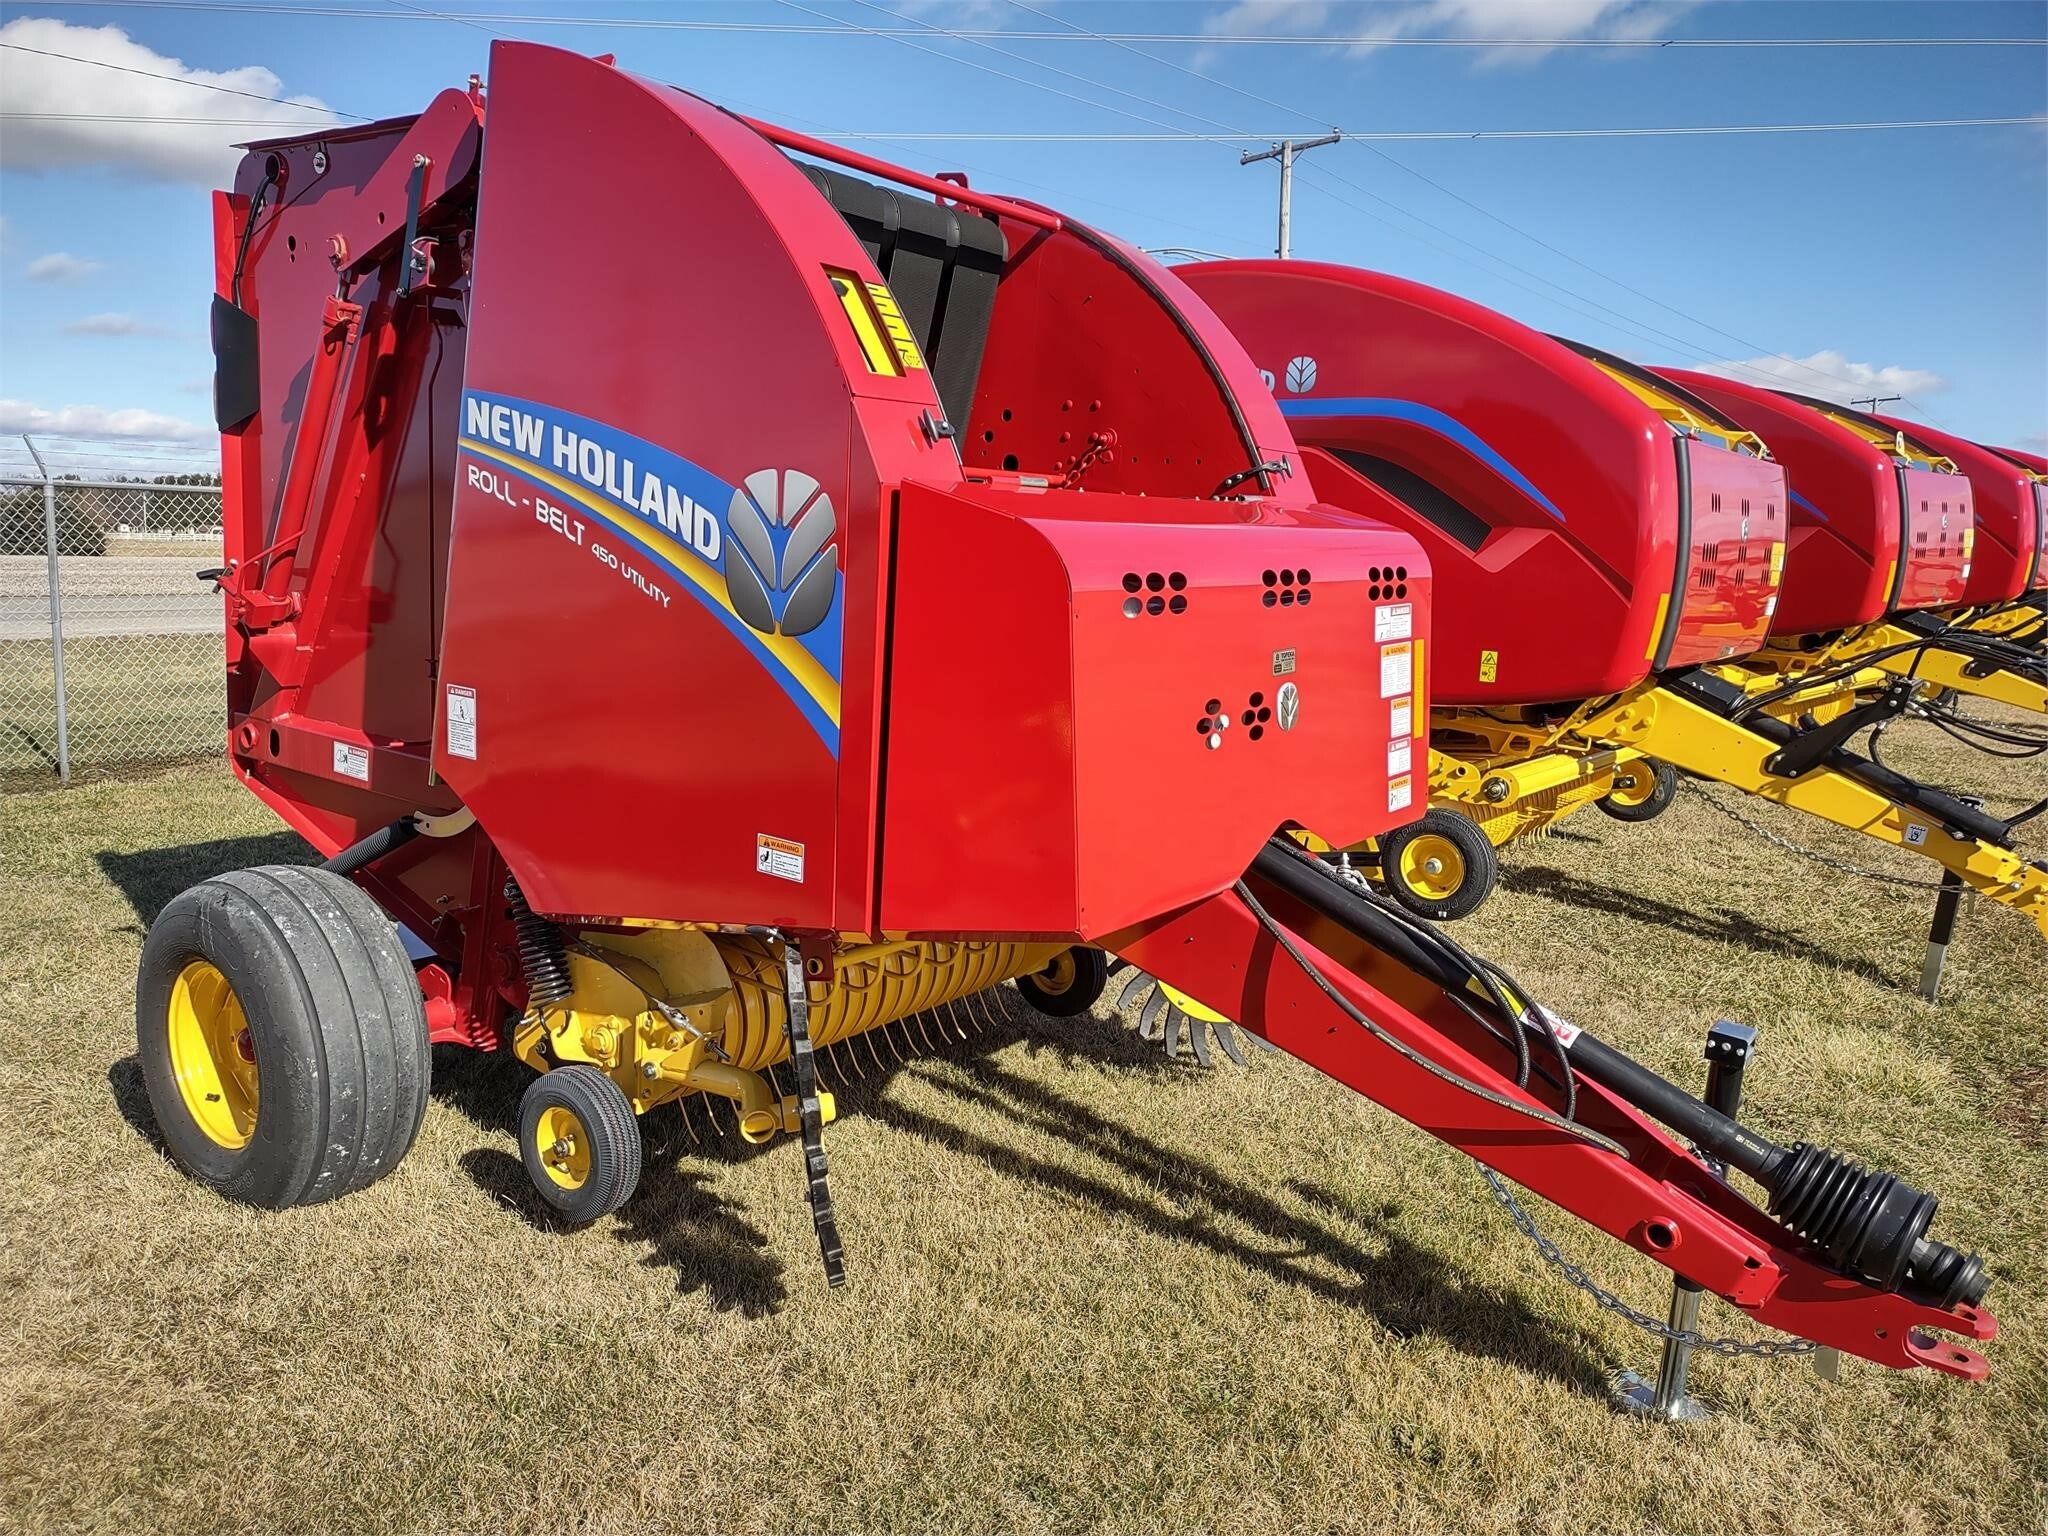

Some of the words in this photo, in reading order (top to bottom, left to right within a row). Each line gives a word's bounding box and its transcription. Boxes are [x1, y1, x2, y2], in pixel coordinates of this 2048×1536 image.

[467, 397, 544, 459] NEW
[552, 425, 721, 561] HOLLAND
[468, 464, 516, 508] ROLL
[535, 499, 586, 546] BELT
[591, 542, 618, 570] 450
[621, 566, 671, 608] UTILITY
[770, 841, 800, 853] WARNING
